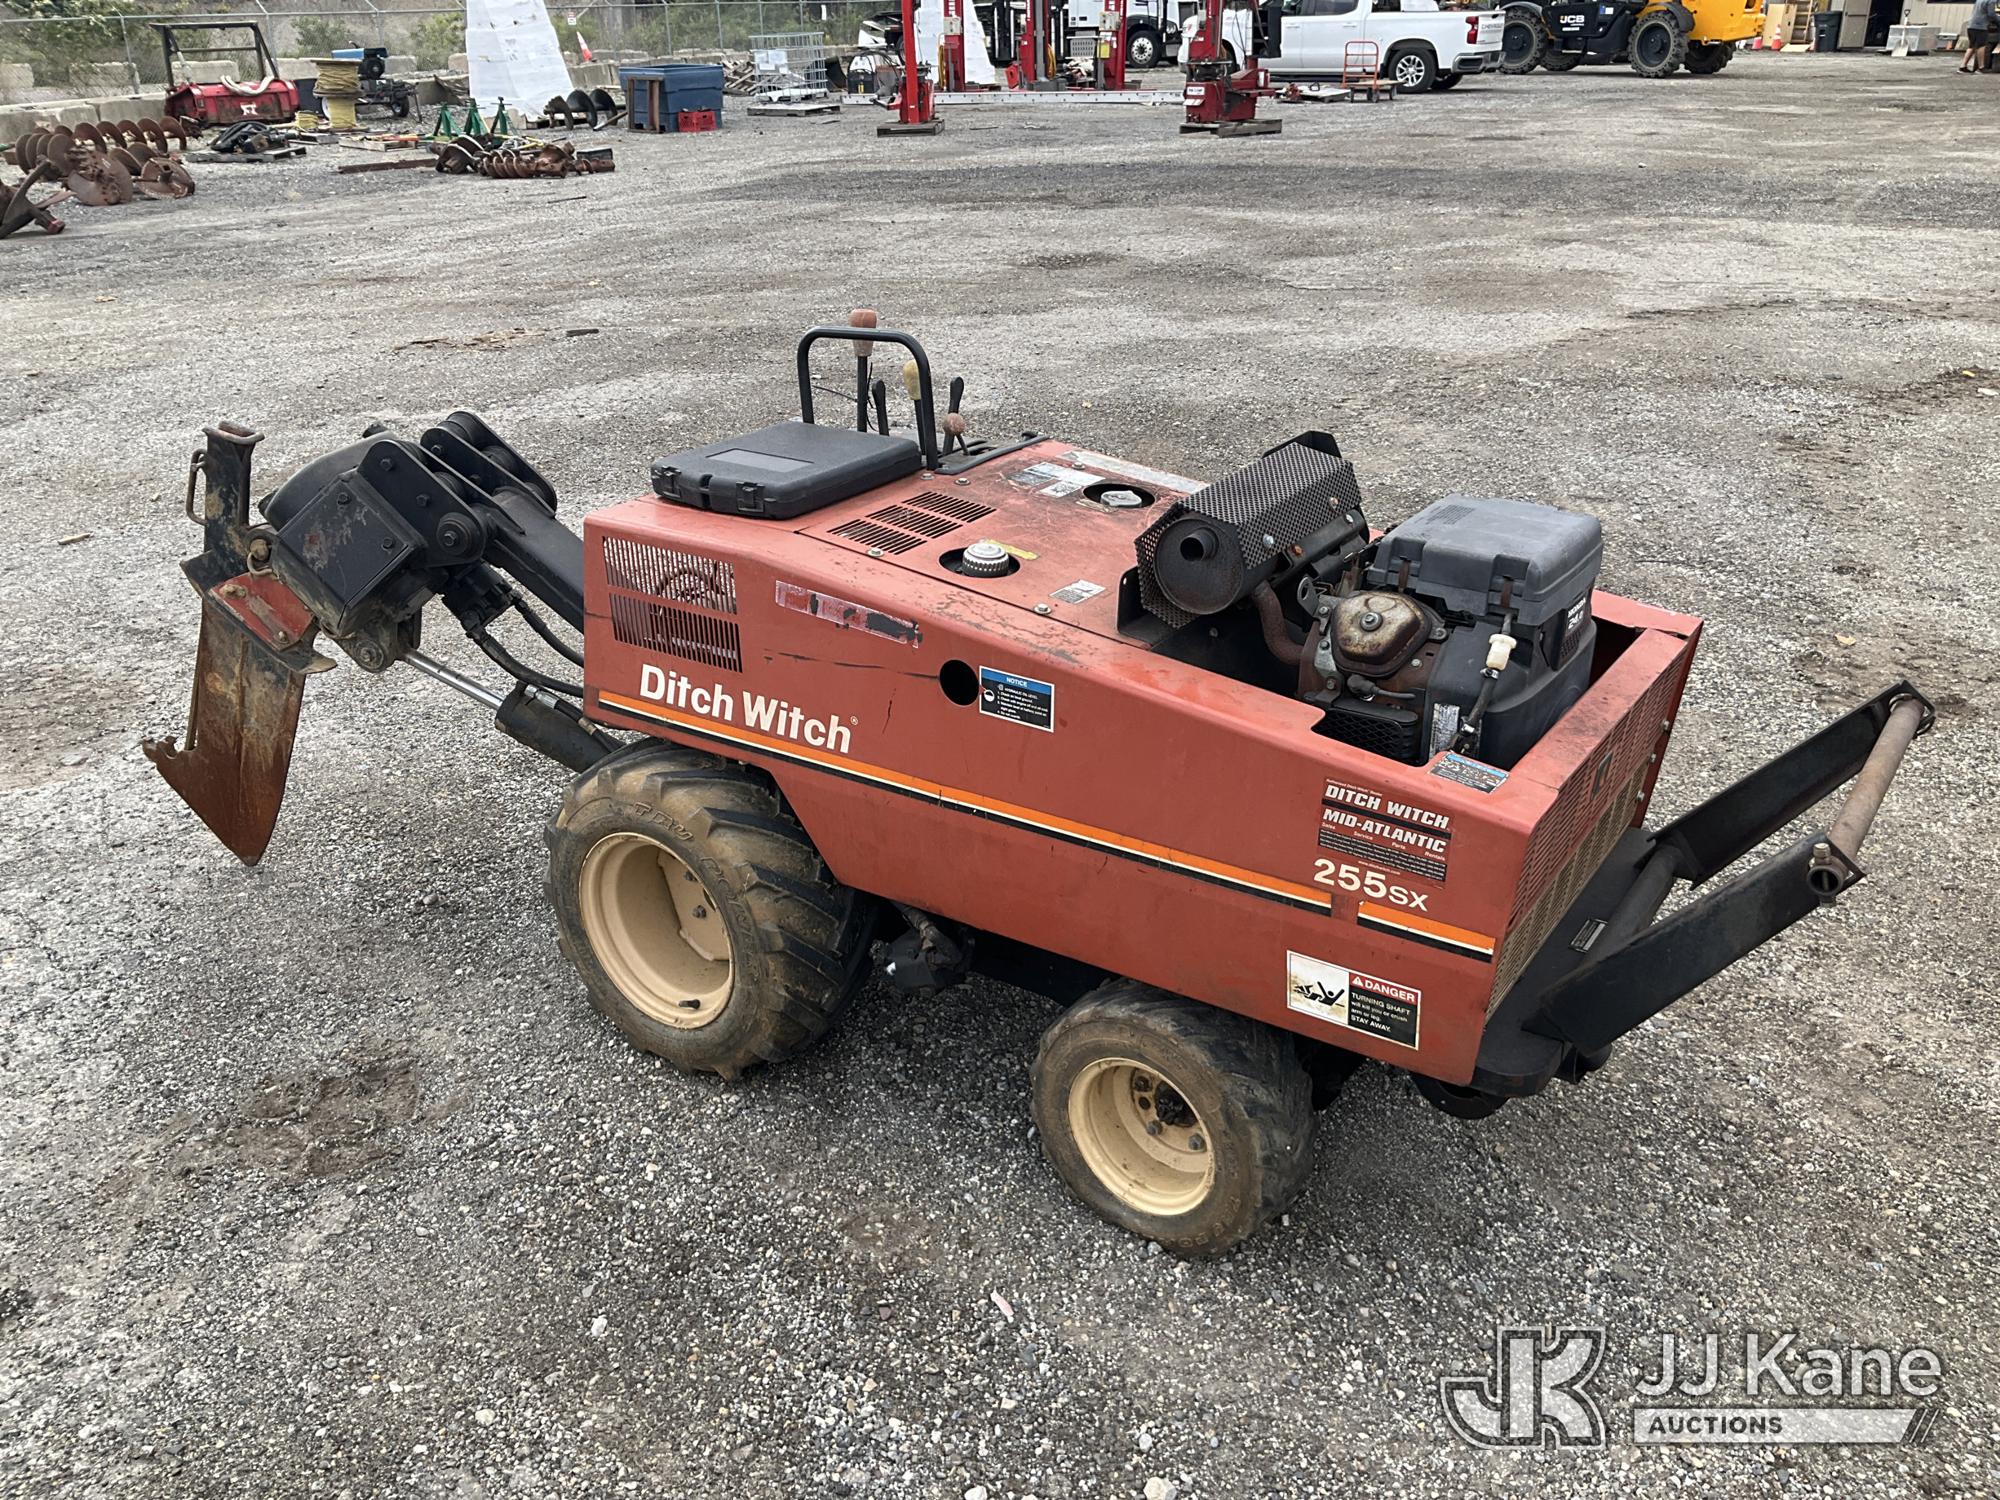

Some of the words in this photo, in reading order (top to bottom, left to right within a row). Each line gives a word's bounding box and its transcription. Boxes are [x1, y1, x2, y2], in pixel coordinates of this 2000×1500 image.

[1560, 15, 1585, 24] JCB
[640, 663, 734, 721] Ditch
[1006, 676, 1028, 688] NOTICE
[1325, 784, 1381, 810] DITCH
[1386, 801, 1449, 829] WITCH
[1322, 822, 1336, 830] Sales
[1353, 830, 1374, 841] Service
[1391, 841, 1406, 850] Parts
[1424, 851, 1446, 862] Rentals
[1323, 808, 1447, 853] MID-ATLANTIC
[1365, 979, 1415, 1002] DANGER
[1351, 992, 1385, 1008] TURNING
[1386, 1002, 1411, 1016] SHAFT
[1361, 1003, 1371, 1011] kill
[1371, 1007, 1382, 1016] you
[1390, 1012, 1408, 1022] crush
[1351, 1015, 1369, 1025] STAY
